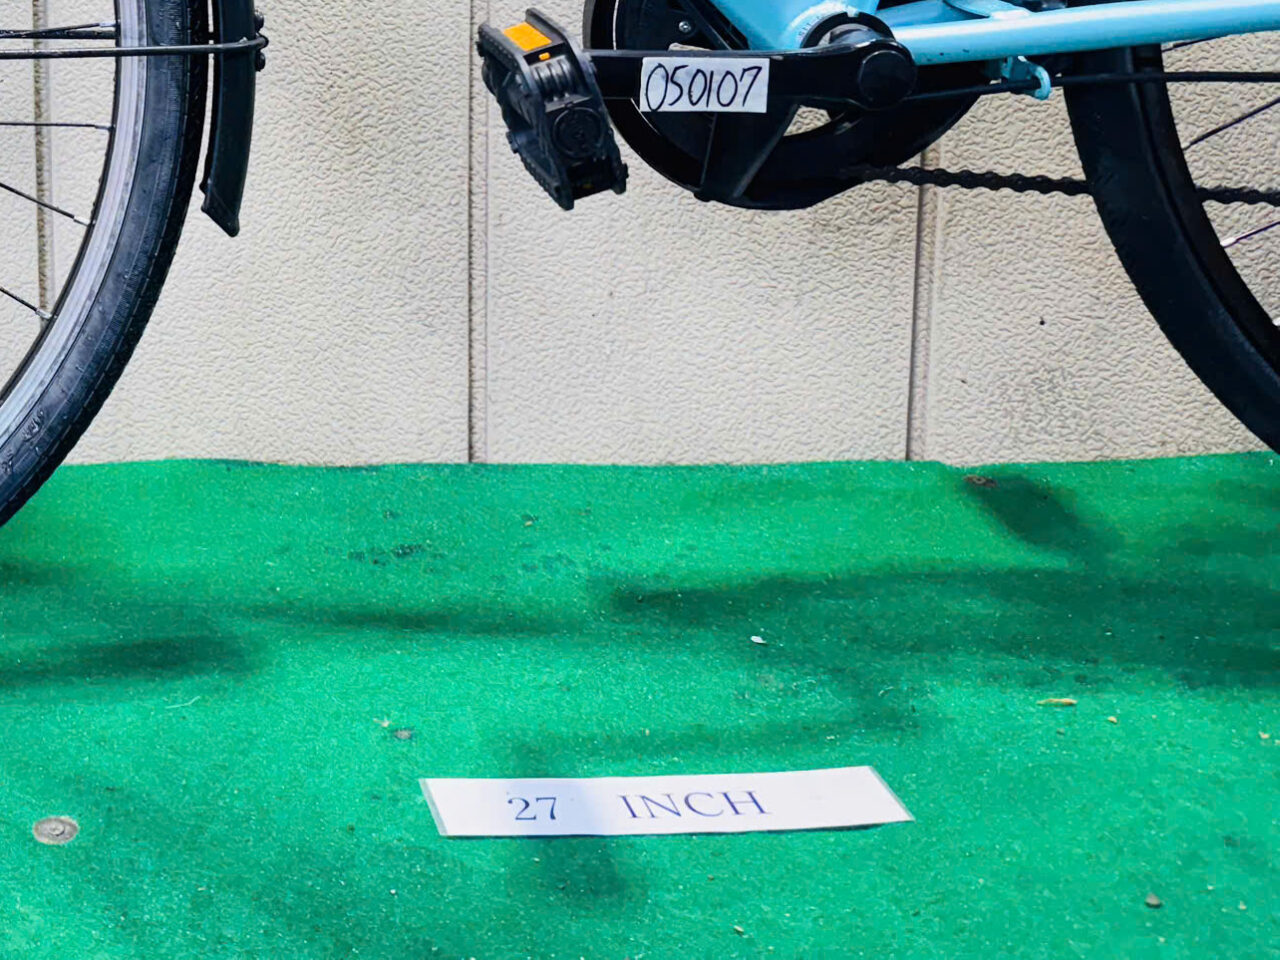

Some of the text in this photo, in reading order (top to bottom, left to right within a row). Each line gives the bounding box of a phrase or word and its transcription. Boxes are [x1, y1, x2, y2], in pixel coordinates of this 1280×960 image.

[645, 63, 762, 112] 050107
[508, 790, 772, 820] 27 INCH
